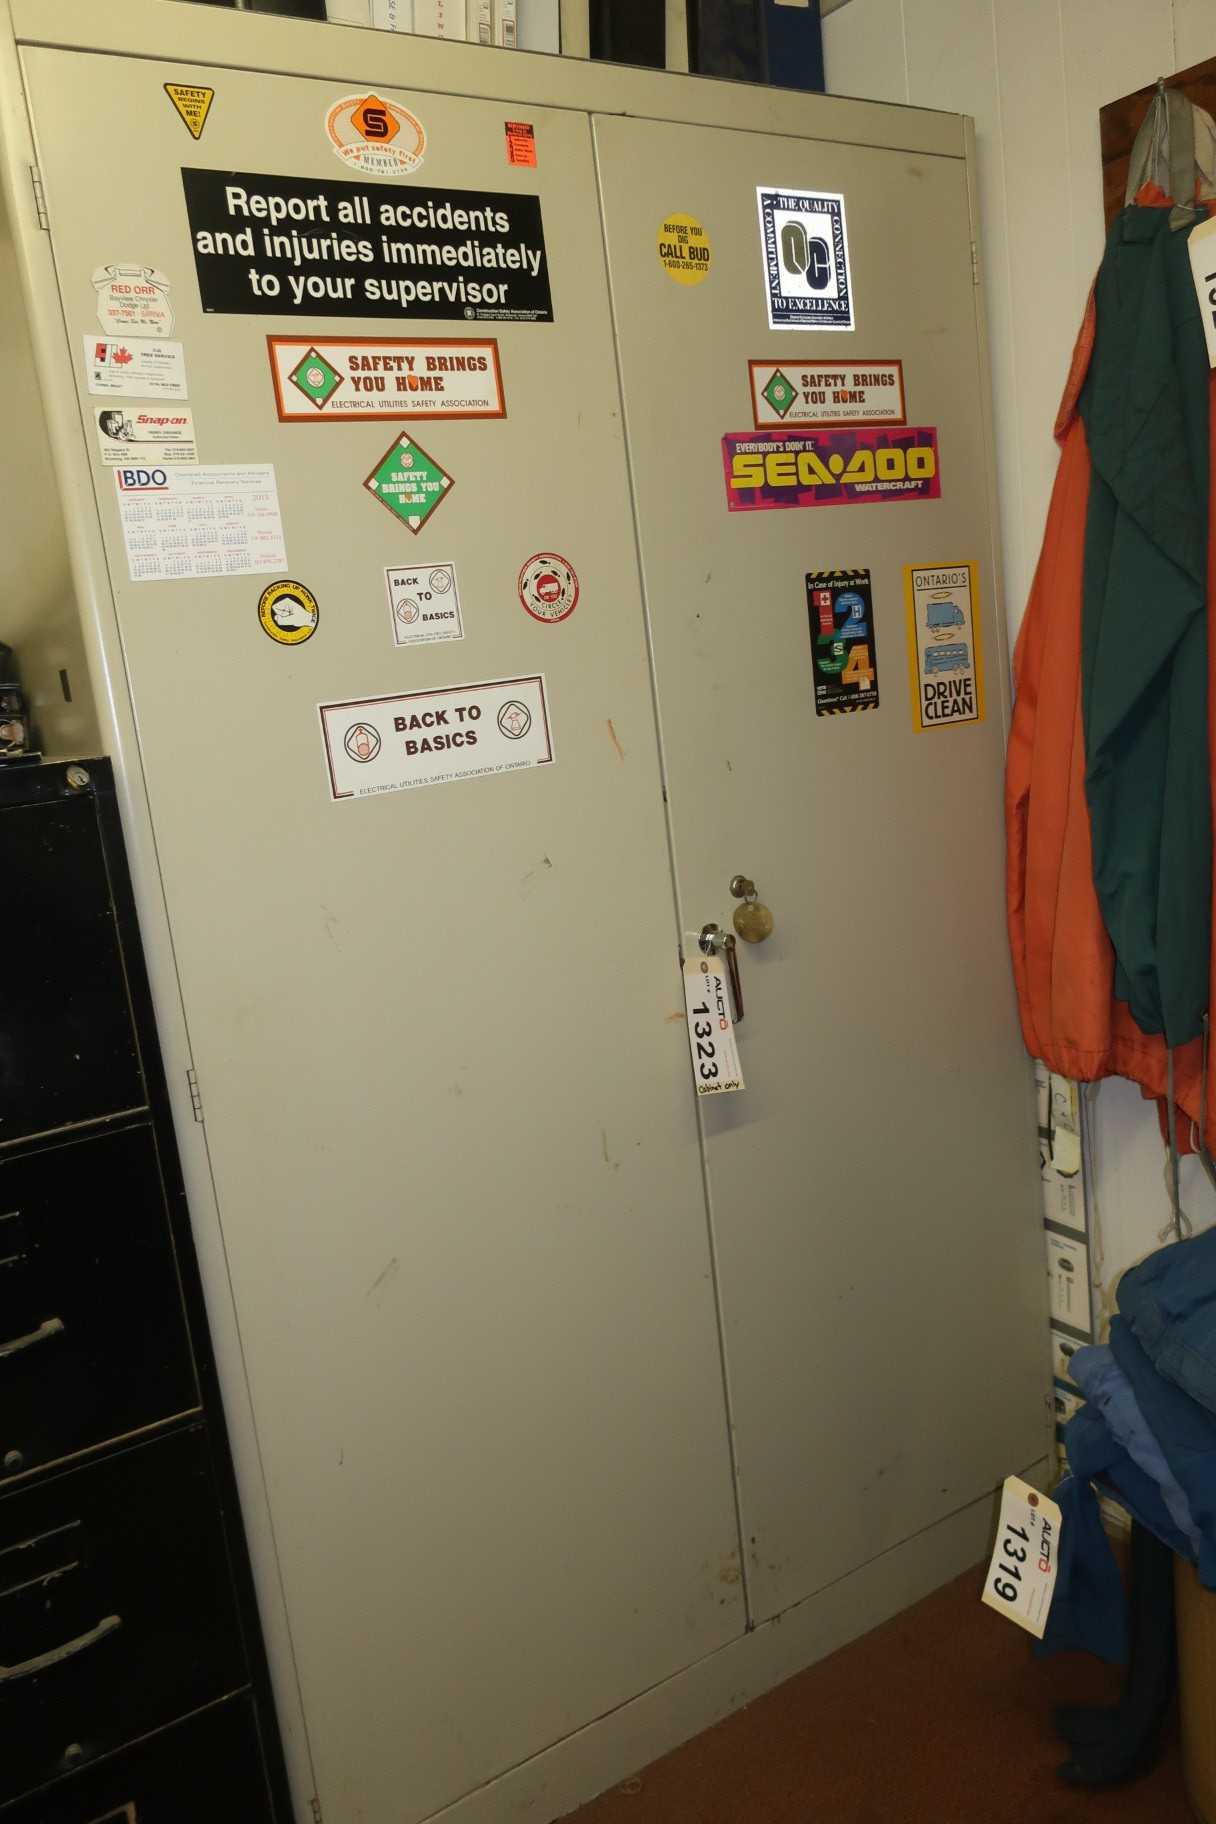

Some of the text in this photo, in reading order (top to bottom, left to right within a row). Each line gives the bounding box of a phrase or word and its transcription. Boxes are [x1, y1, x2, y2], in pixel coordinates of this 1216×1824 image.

[174, 88, 206, 98] SAFETY
[224, 186, 510, 233] Report all accidents
[778, 197, 838, 214] THE QUALITY
[664, 224, 702, 236] BEFORE YOU
[196, 228, 541, 276] and injuries immediately
[659, 242, 710, 262] CALL BUD
[764, 209, 780, 297] COMMITMENT
[832, 216, 848, 297] CONNECTION
[111, 284, 156, 294] RED ORR
[249, 268, 508, 308] to your supervisor
[772, 298, 848, 312] TO EXCELLENCE
[348, 355, 488, 372] SAFETY BRINGS
[350, 374, 446, 392] YOU HOME
[801, 374, 895, 388] SAFETY BRINGS
[332, 400, 489, 409] ELECTRICAL UTILITIES SAFETY ASSOCIATION
[802, 390, 866, 404] YOU HOME
[136, 414, 188, 426] Snap-on
[736, 442, 784, 452] EVERYBODY'S
[123, 469, 167, 486] BDO
[391, 472, 428, 482] SAFETY
[382, 482, 440, 494] BRINGS YOU
[854, 480, 923, 492] WATERCRAFT
[399, 492, 426, 504] HOME
[394, 578, 420, 586] BACK
[828, 580, 833, 588] of
[833, 580, 848, 589] Injury
[855, 578, 869, 586] Work
[915, 572, 967, 588] ONTARIO'S
[416, 592, 432, 601] TO
[422, 612, 455, 621] BASICS
[835, 592, 867, 638] 2
[842, 644, 874, 690] 4
[924, 678, 972, 702] DRIVE
[924, 696, 974, 720] CLEAN
[394, 706, 482, 732] BACK TO
[405, 730, 478, 756] BASICS
[360, 784, 398, 794] ELECTRICAL
[400, 778, 428, 788] UTILITIES
[430, 774, 453, 784] SAFETY
[454, 768, 494, 778] ASSOCIATION
[692, 1002, 718, 1080] 1323
[724, 1080, 740, 1090] only
[994, 1524, 1030, 1602] 1319
